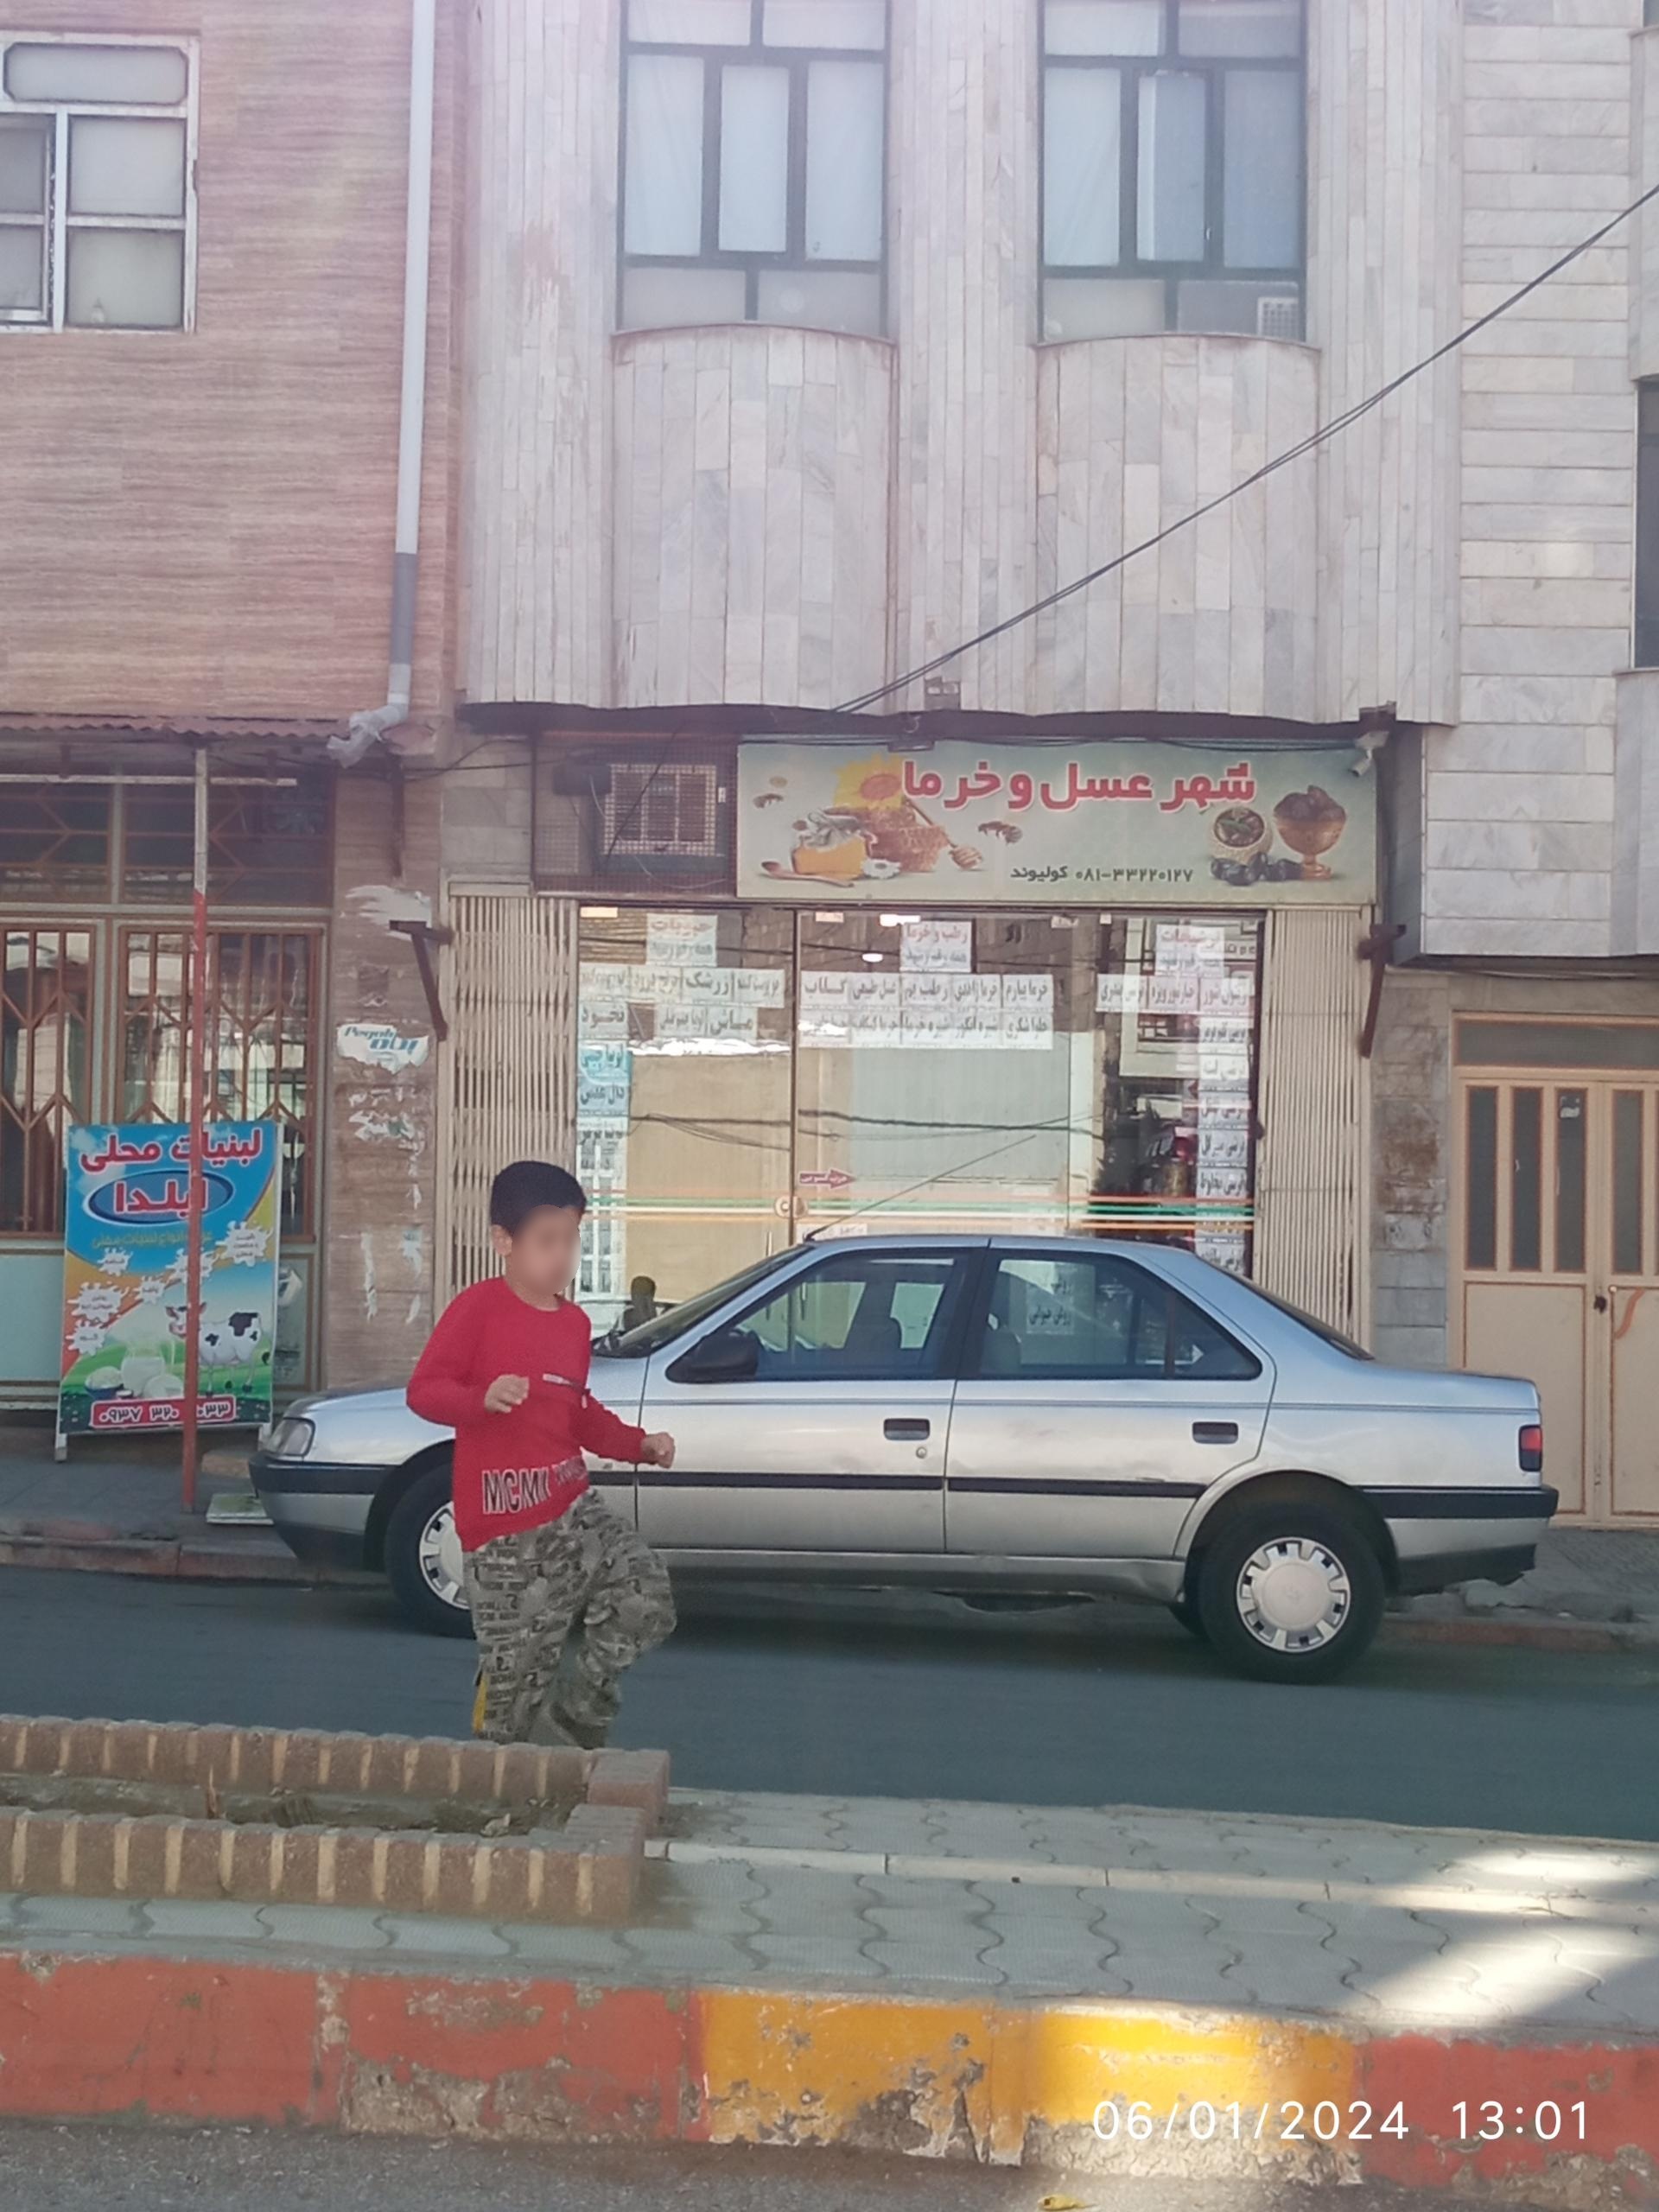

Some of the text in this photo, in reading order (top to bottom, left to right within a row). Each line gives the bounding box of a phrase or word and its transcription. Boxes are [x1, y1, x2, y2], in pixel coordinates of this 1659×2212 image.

[905, 761, 1255, 810] شهر عسل و خرما
[1009, 866, 1069, 882] کولیوند
[906, 924, 931, 943] خرما
[942, 925, 968, 944] رطب
[685, 970, 730, 995] زرشک
[918, 977, 948, 1001] رطب
[1029, 979, 1048, 1001] خرما
[582, 1003, 626, 1029] نخود
[709, 1008, 754, 1036] ماش
[79, 1128, 263, 1174] لبنیات محلی
[194, 1401, 232, 1418] ۰۳۳
